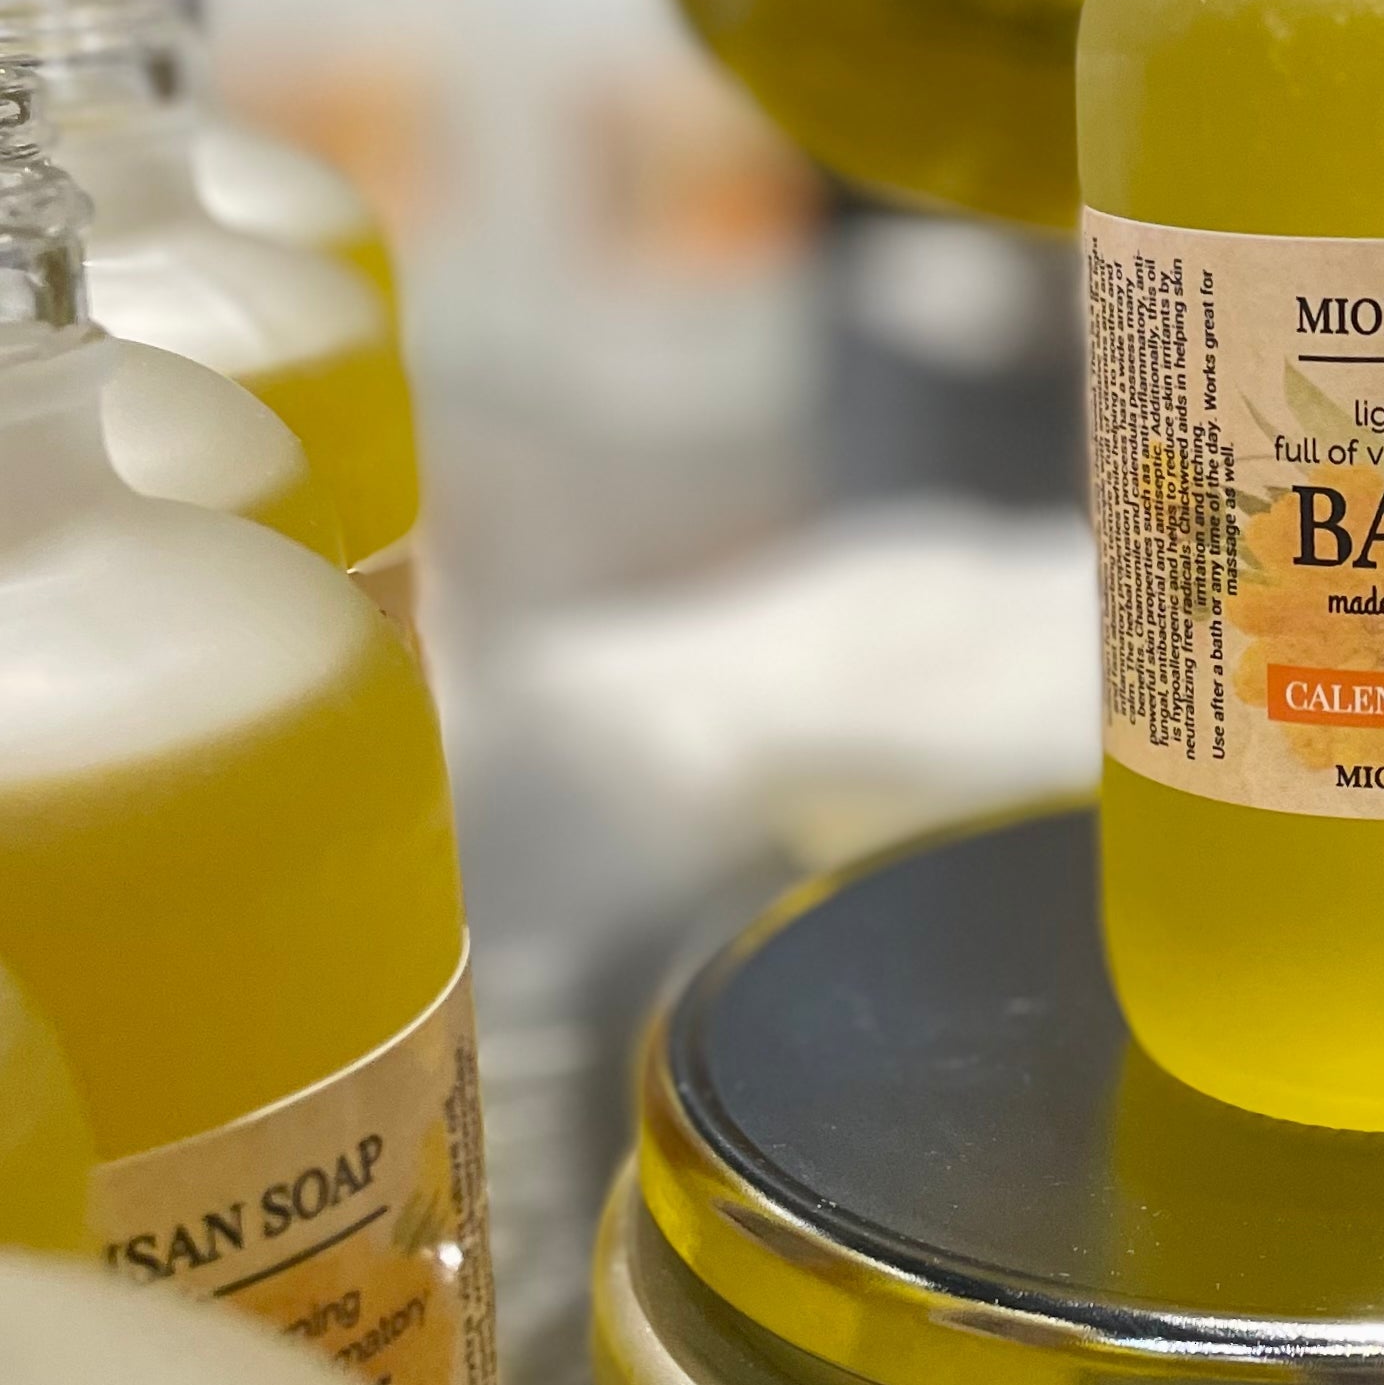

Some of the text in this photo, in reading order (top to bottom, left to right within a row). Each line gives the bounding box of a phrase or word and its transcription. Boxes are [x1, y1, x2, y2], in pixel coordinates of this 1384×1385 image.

[1114, 261, 1122, 280] of
[1145, 260, 1155, 281] oil
[1171, 258, 1184, 296] skin
[1108, 303, 1116, 363] soothe
[1116, 285, 1124, 331] array
[1146, 287, 1156, 319] this
[1117, 336, 1125, 377] wide
[1173, 302, 1187, 368] helping
[1110, 369, 1116, 386] to
[1120, 382, 1125, 393] a
[1148, 325, 1161, 436] Additionally,
[1175, 374, 1186, 390] in
[1111, 392, 1119, 455] helping
[1119, 398, 1127, 429] has
[1176, 395, 1188, 433] aids
[1121, 435, 1131, 504] process
[1274, 438, 1319, 463] full
[1328, 437, 1359, 466] of
[1125, 277, 1146, 717] benefits. Chamomile and calendula possess many
[1133, 249, 1159, 745] powerful skin properties such as anti-inflammatory, anti-
[1159, 271, 1184, 742] is hypoallergenic and helps to reduce skin irritants by
[1176, 438, 1191, 534] Chickweed
[1190, 422, 1206, 606] irritation and itching.
[1200, 269, 1225, 759] Use after a bath or any time of the day. Works great for
[1123, 509, 1131, 579] infusion
[1220, 442, 1240, 595] massage as well.
[1115, 512, 1125, 598] properties
[1154, 539, 1166, 571] and
[1124, 584, 1133, 637] herbal
[1155, 576, 1168, 684] antibacterial
[1182, 619, 1193, 652] free
[1118, 604, 1127, 716] inflammatory
[1126, 641, 1135, 672] The
[1158, 690, 1169, 746] fungal,
[1181, 658, 1196, 760] neutralizing
[261, 1134, 382, 1238] SOAP
